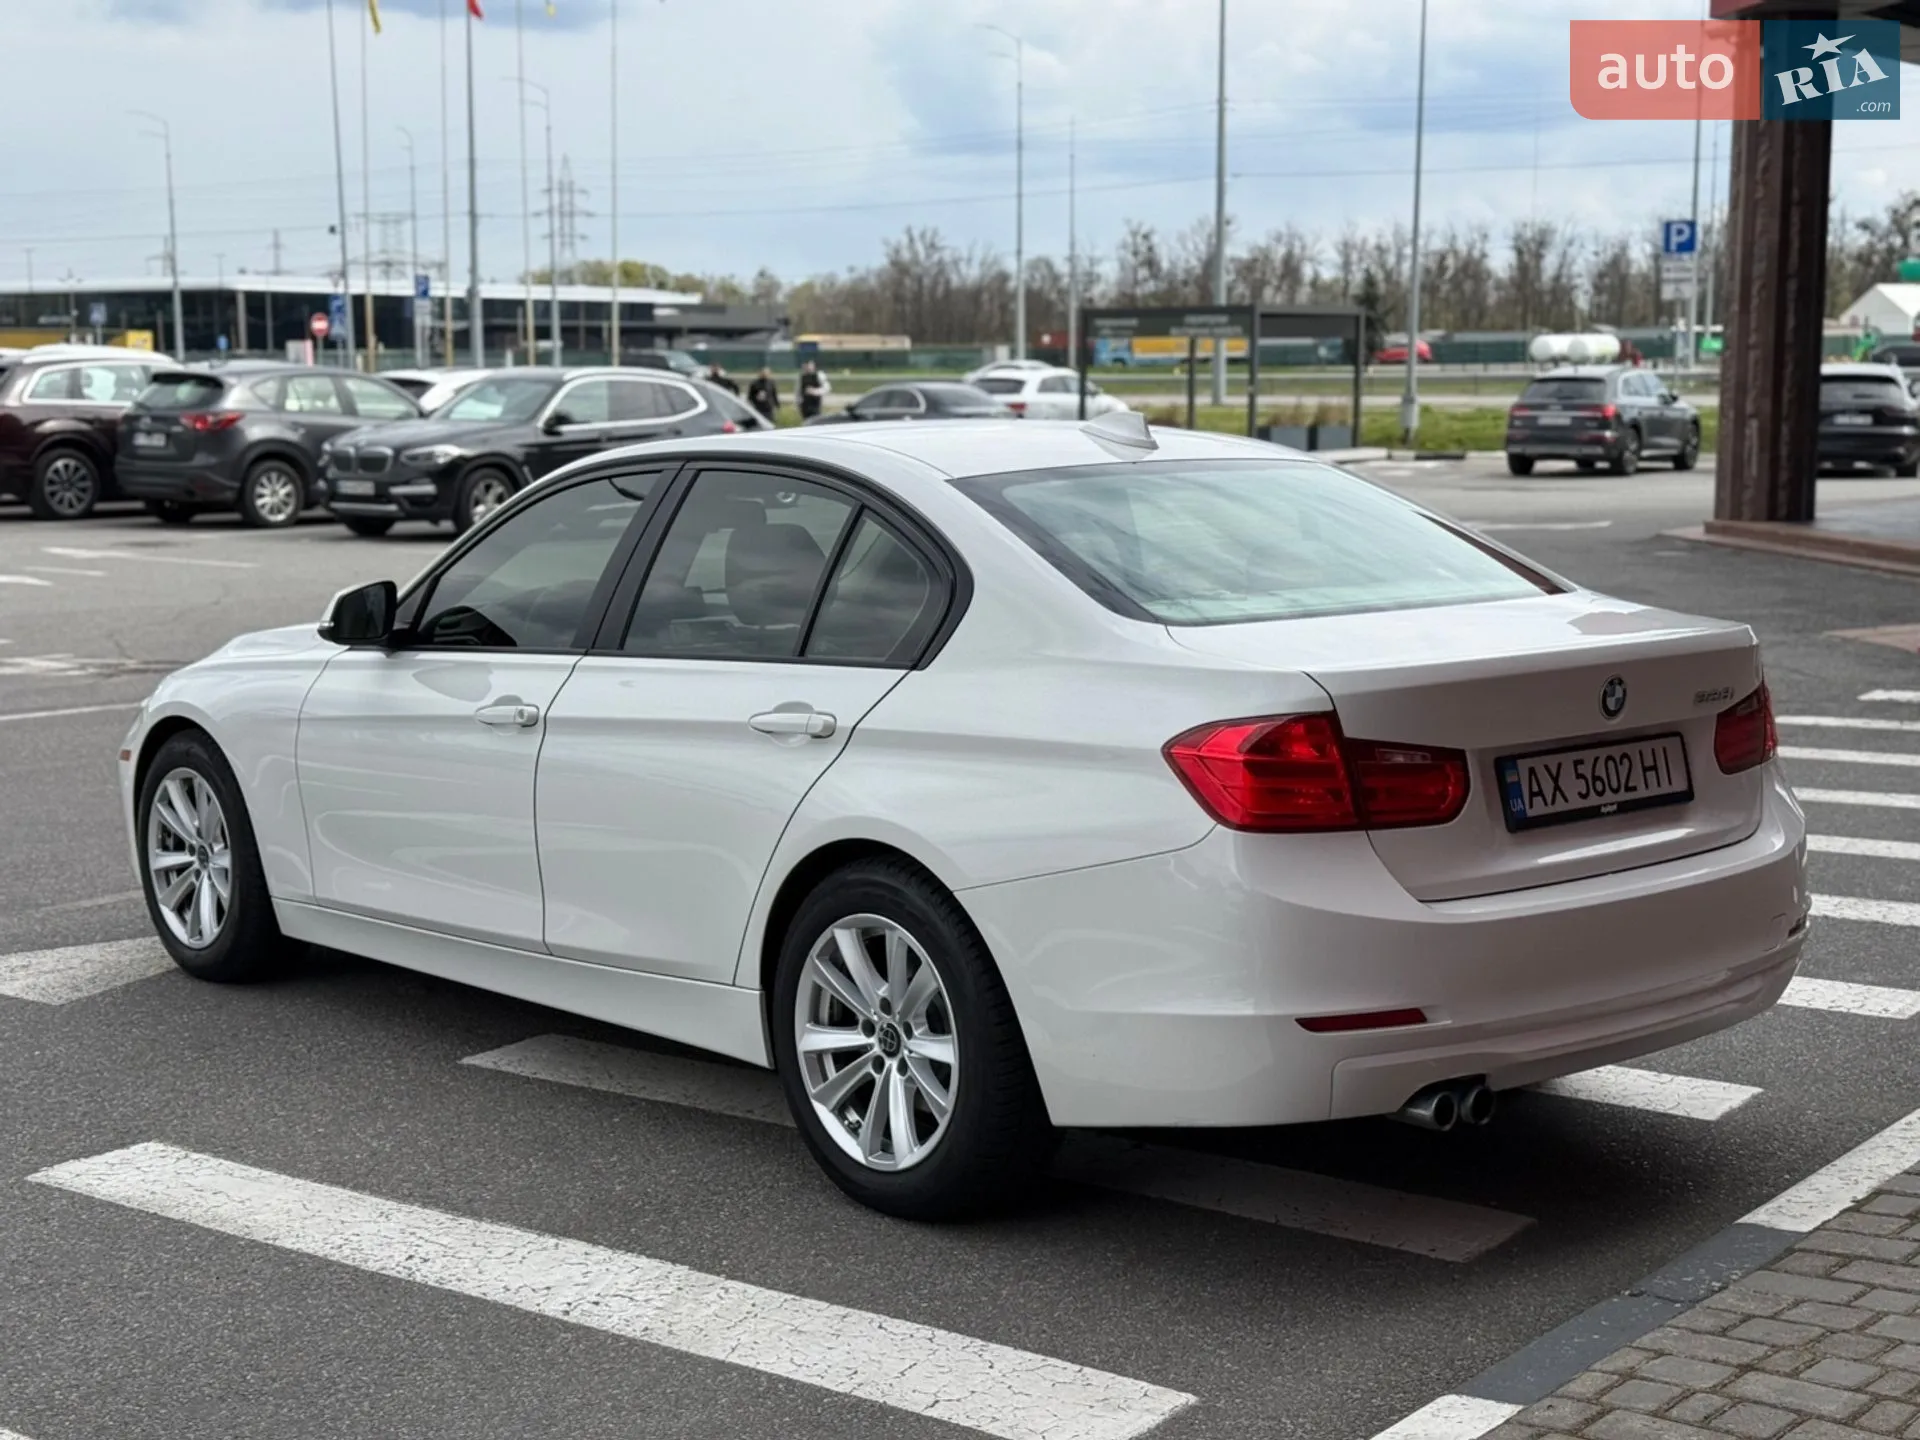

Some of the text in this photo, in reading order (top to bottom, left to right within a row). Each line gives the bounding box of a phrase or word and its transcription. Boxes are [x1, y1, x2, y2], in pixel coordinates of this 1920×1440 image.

[1670, 223, 1691, 252] P
[1528, 746, 1673, 809] AX 5602 HI
[1509, 797, 1525, 813] UA
